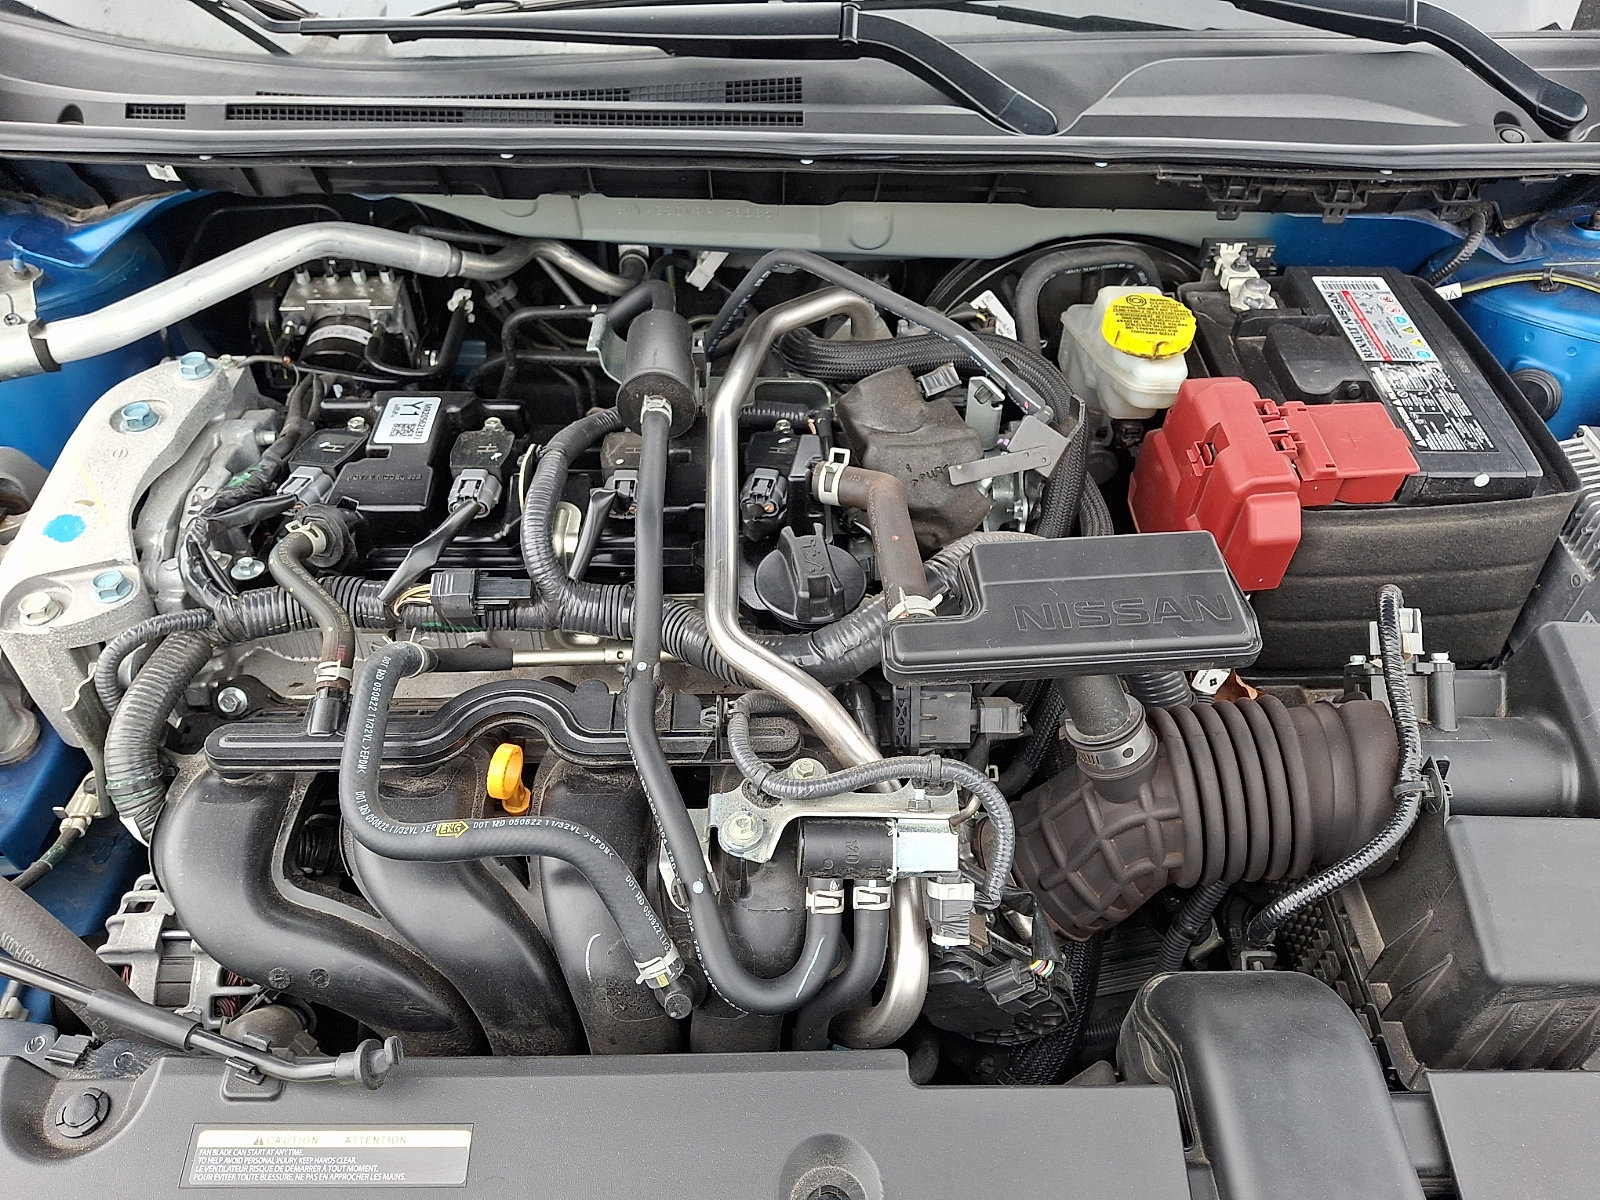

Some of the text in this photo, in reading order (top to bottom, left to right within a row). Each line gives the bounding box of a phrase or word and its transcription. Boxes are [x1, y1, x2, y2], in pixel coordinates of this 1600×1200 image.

[1325, 291, 1353, 324] NISSAN
[400, 400, 424, 416] Y1
[1012, 594, 1233, 631] NISSAN
[368, 682, 382, 712] 050822
[472, 821, 489, 829] DOT
[625, 875, 638, 891] DOT
[643, 906, 662, 935] 050822
[266, 1136, 408, 1144] CAUTION ATTENTION
[198, 1156, 206, 1164] TO
[208, 1156, 223, 1164] HELP
[224, 1156, 244, 1164] AVOID
[244, 1156, 274, 1164] PERSONAL
[298, 1156, 314, 1164] KEEP
[314, 1156, 336, 1164] HANDS
[195, 1164, 378, 1172] LE VENTILATEUR RISQUE DE DÉMARRER À TOUT MOMENT.
[194, 1173, 406, 1181] POUR ÉVITER TOUTE BLESSURE, NE PAS EN APPROCHER LES MAINS.
